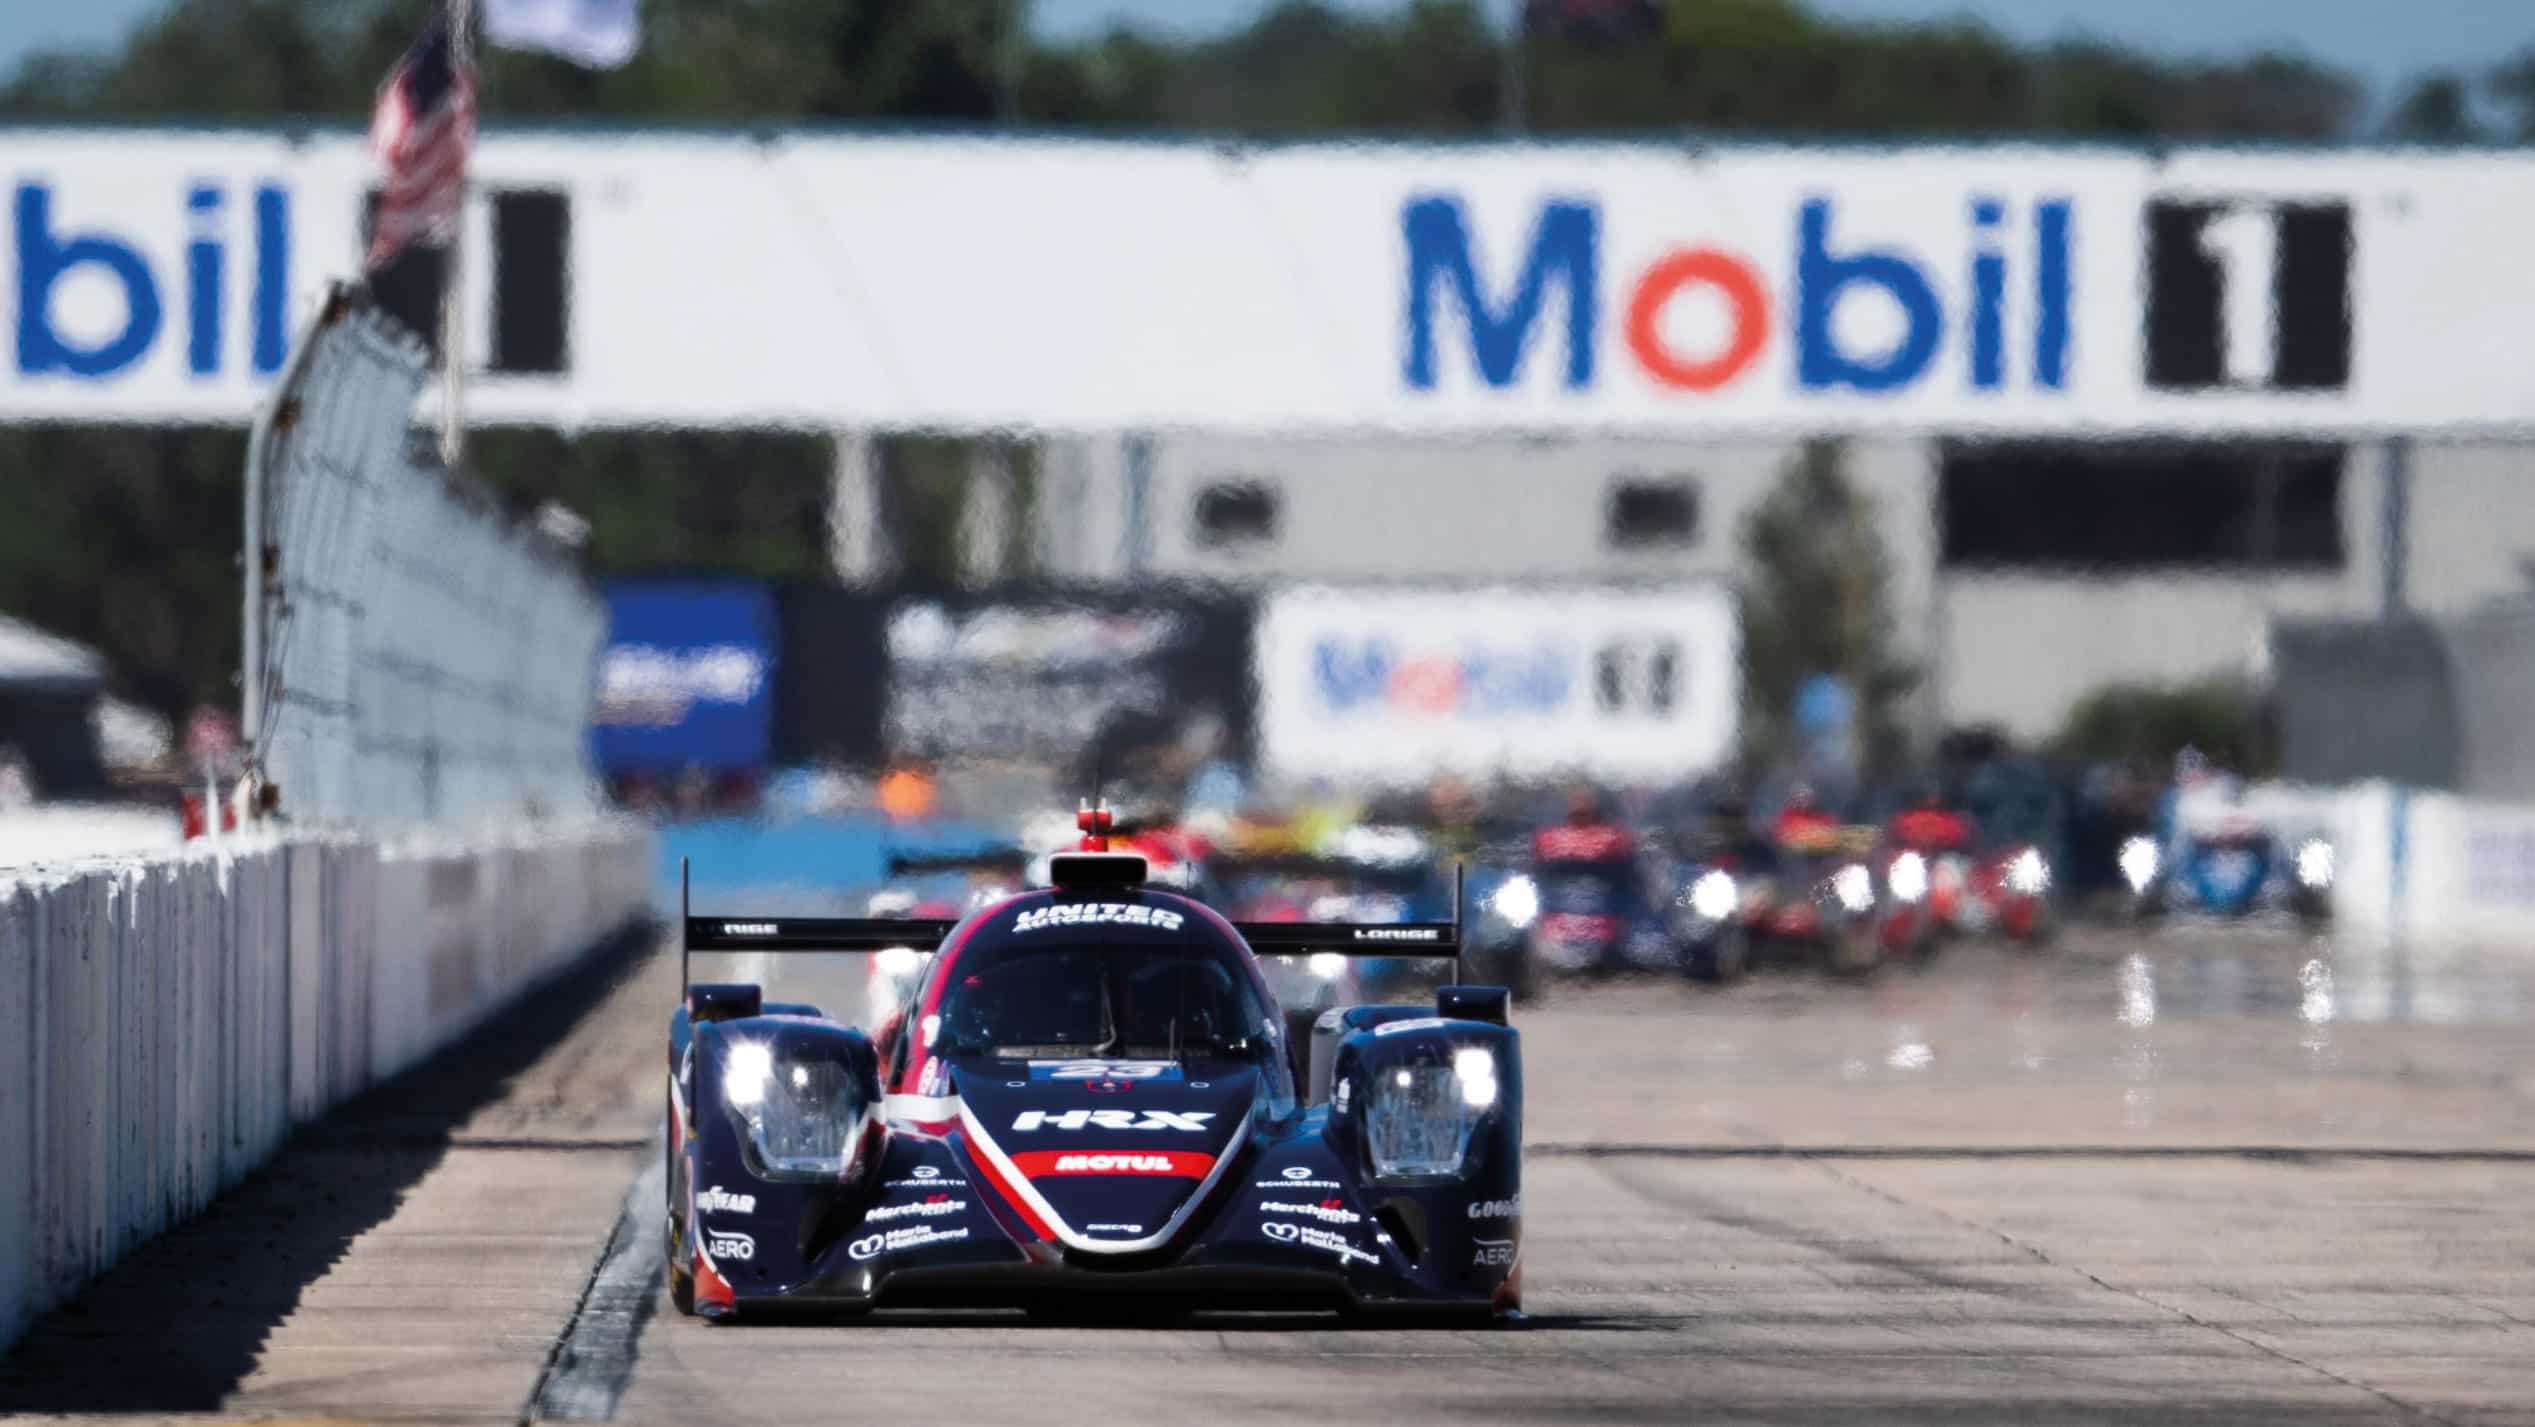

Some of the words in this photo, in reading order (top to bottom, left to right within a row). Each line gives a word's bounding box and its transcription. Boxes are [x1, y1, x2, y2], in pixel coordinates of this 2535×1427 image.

[1402, 197, 2070, 390] Mobil
[1016, 904, 1184, 923] UNITED
[1011, 1110, 1216, 1131] HRX
[1055, 1155, 1173, 1171] MOTUL
[709, 1239, 754, 1260] AERO
